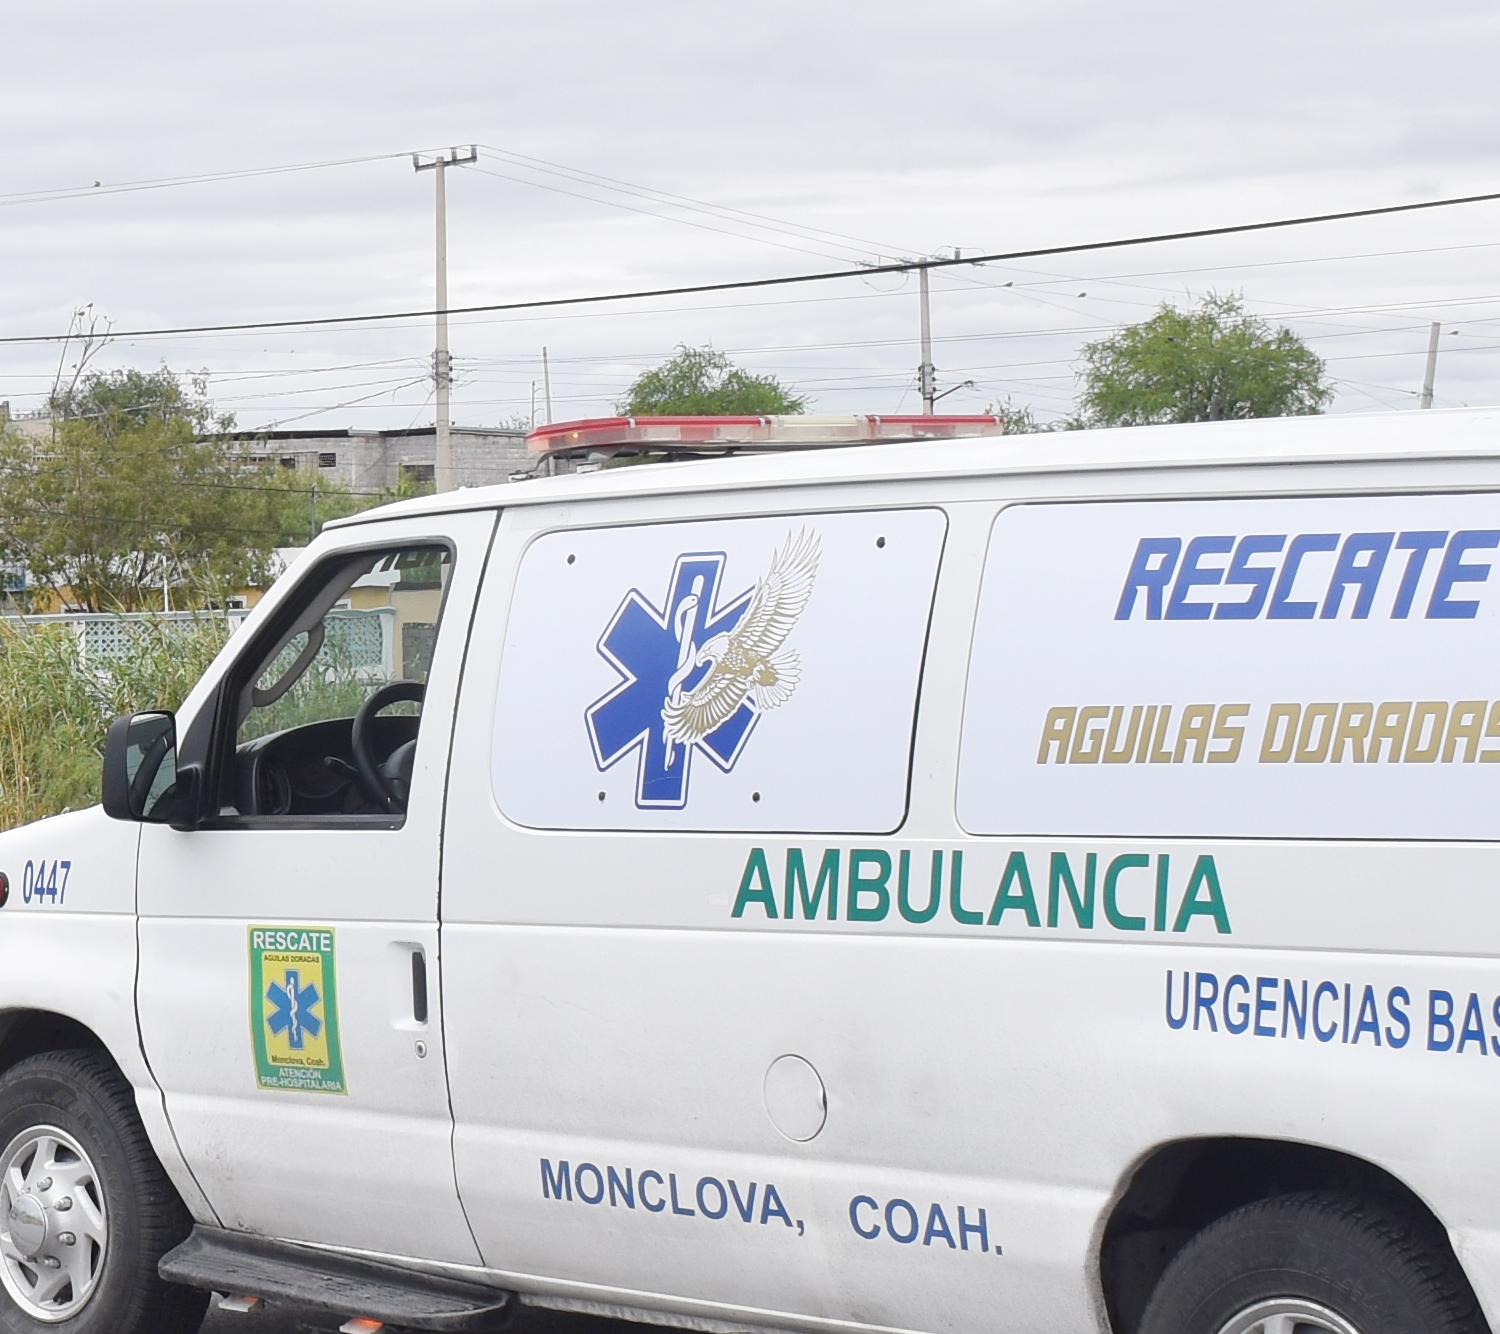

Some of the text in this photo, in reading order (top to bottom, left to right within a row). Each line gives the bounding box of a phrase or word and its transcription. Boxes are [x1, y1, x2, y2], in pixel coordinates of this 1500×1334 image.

[1037, 704, 1246, 765] AGUILAS
[22, 859, 72, 905] 0447
[732, 847, 1233, 935] AMBULANCIA
[252, 931, 333, 952] RESCATE
[1164, 969, 1413, 1051] URGENCIAS
[260, 1075, 343, 1091] PRE-HOSPITALARIA
[540, 1157, 1004, 1257] MONCLOVA, COAH.
